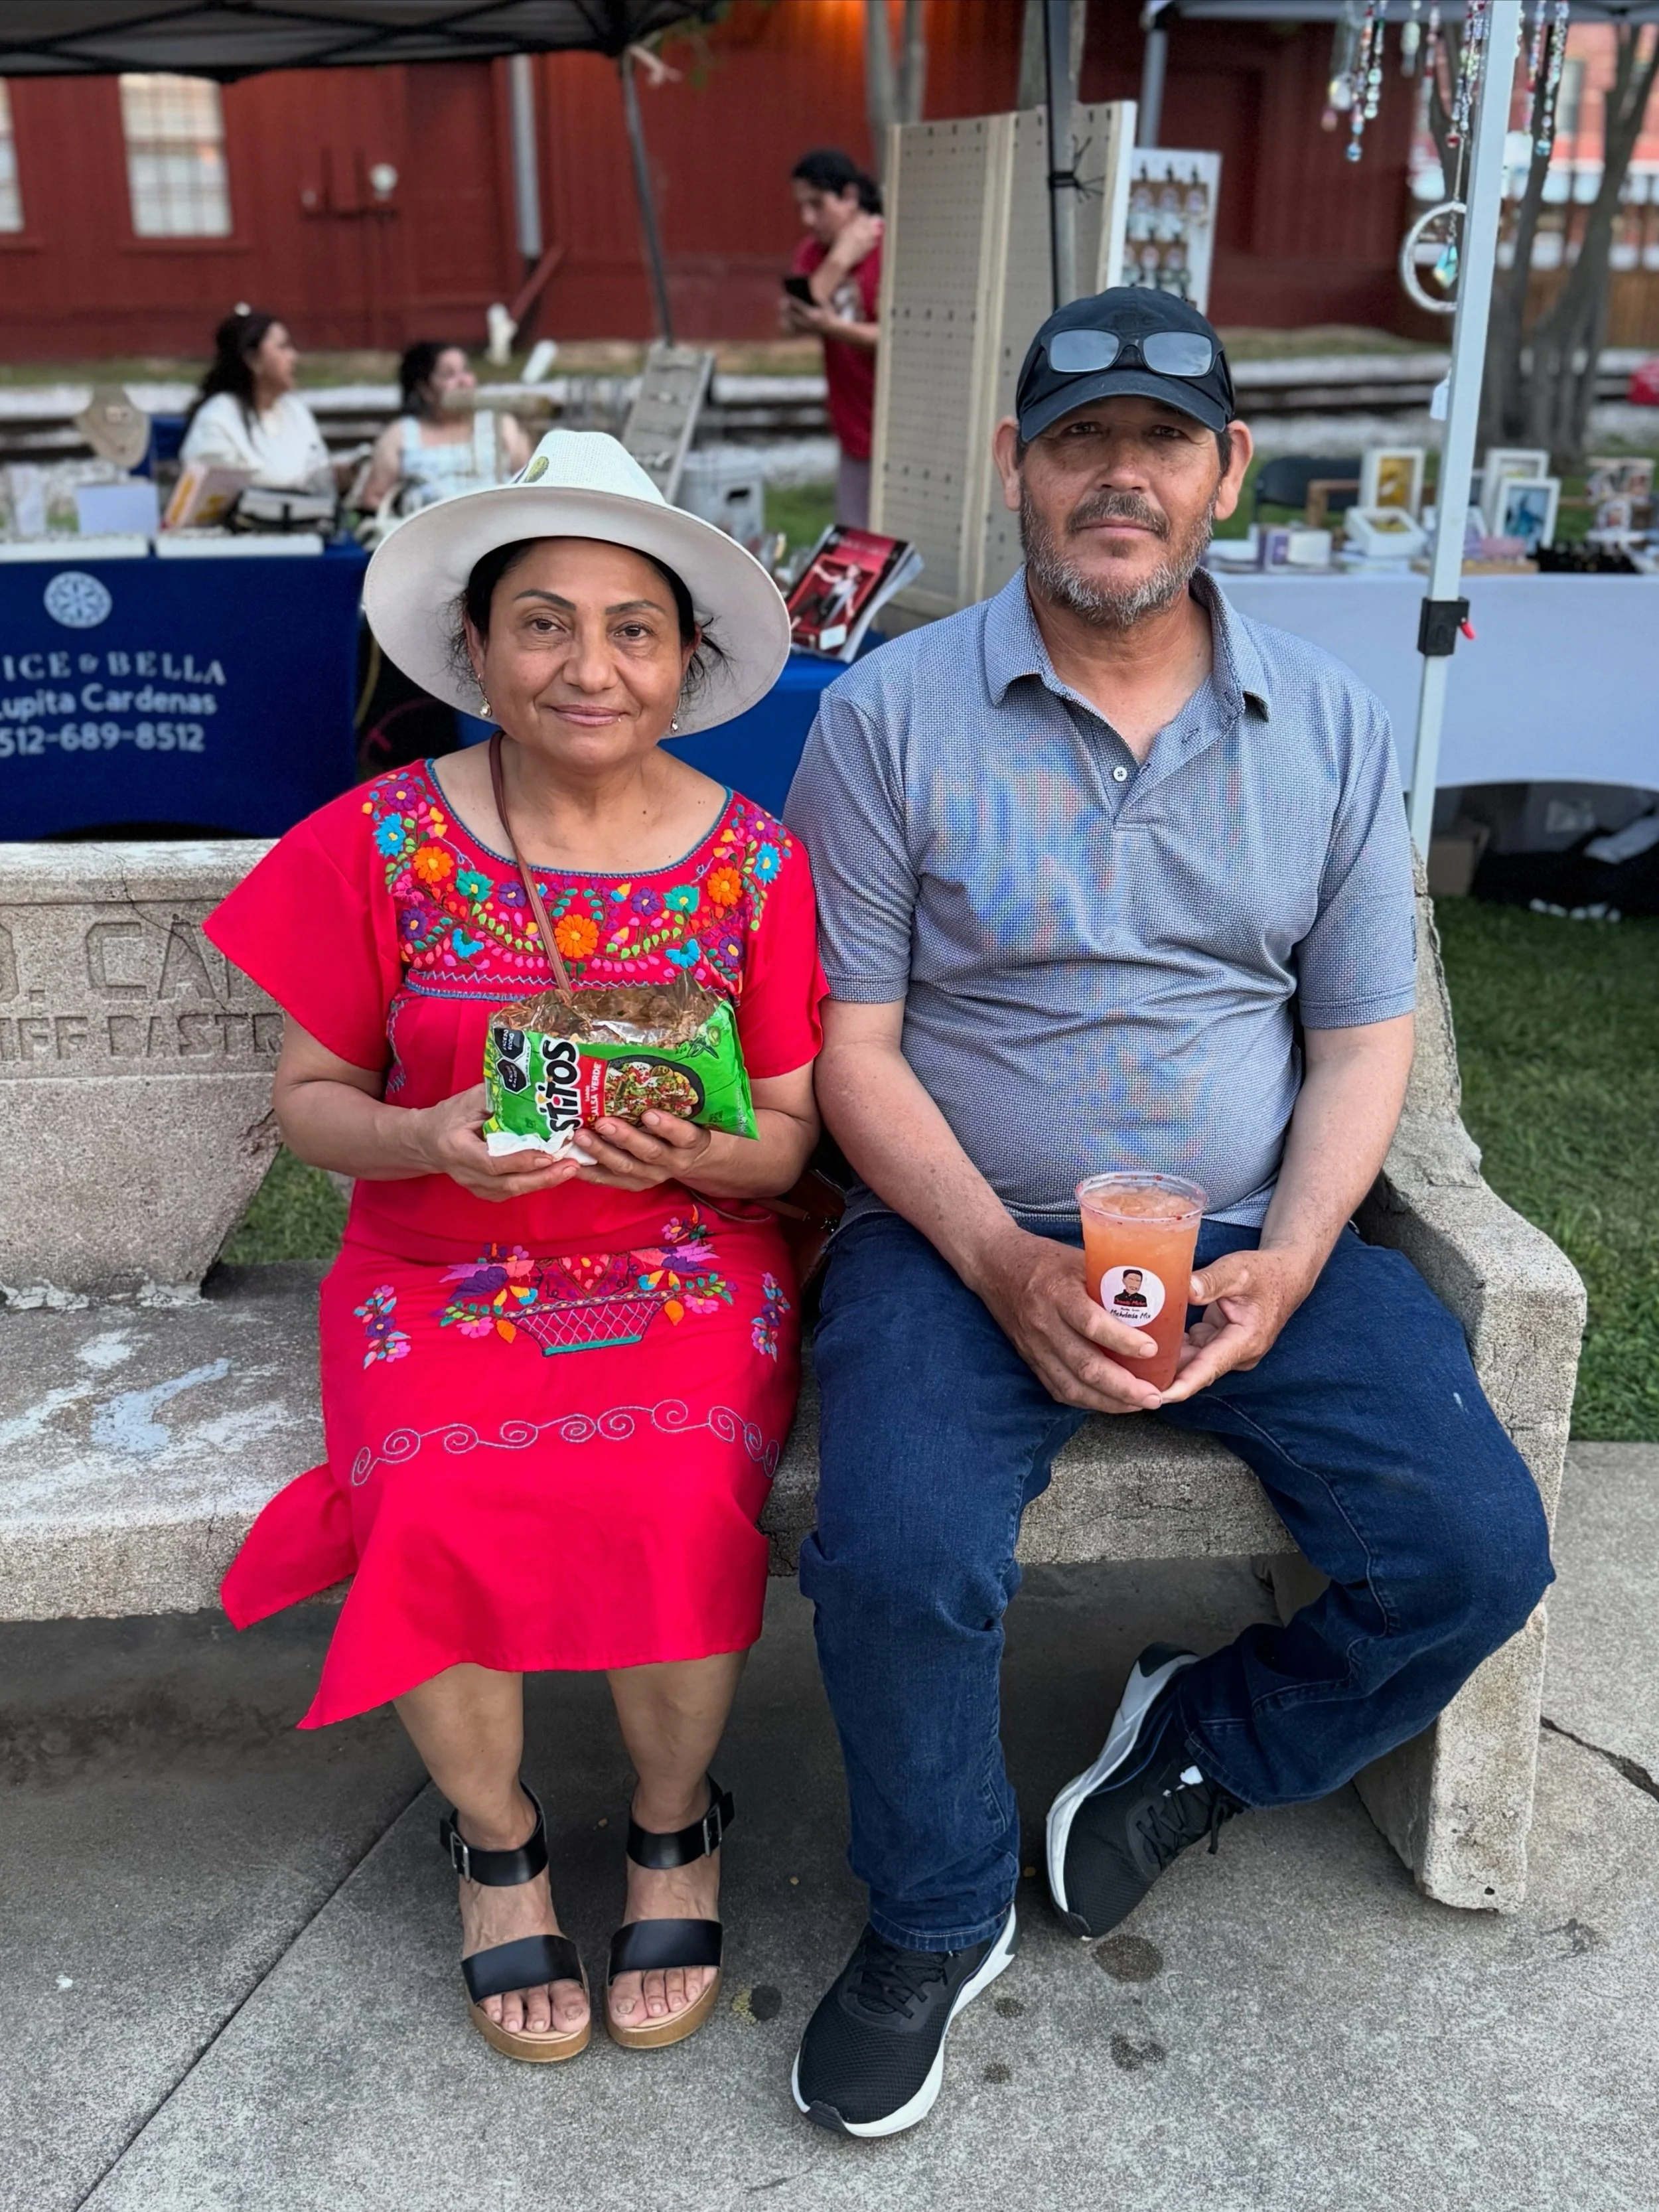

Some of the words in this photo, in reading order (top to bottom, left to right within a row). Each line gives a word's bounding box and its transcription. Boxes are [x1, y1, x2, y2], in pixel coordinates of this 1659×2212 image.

[108, 650, 226, 686] BELLA
[0, 688, 77, 723] upita
[80, 682, 218, 715] Cardenas
[0, 721, 205, 757] 512-689-8512
[591, 1062, 602, 1092] VERDE
